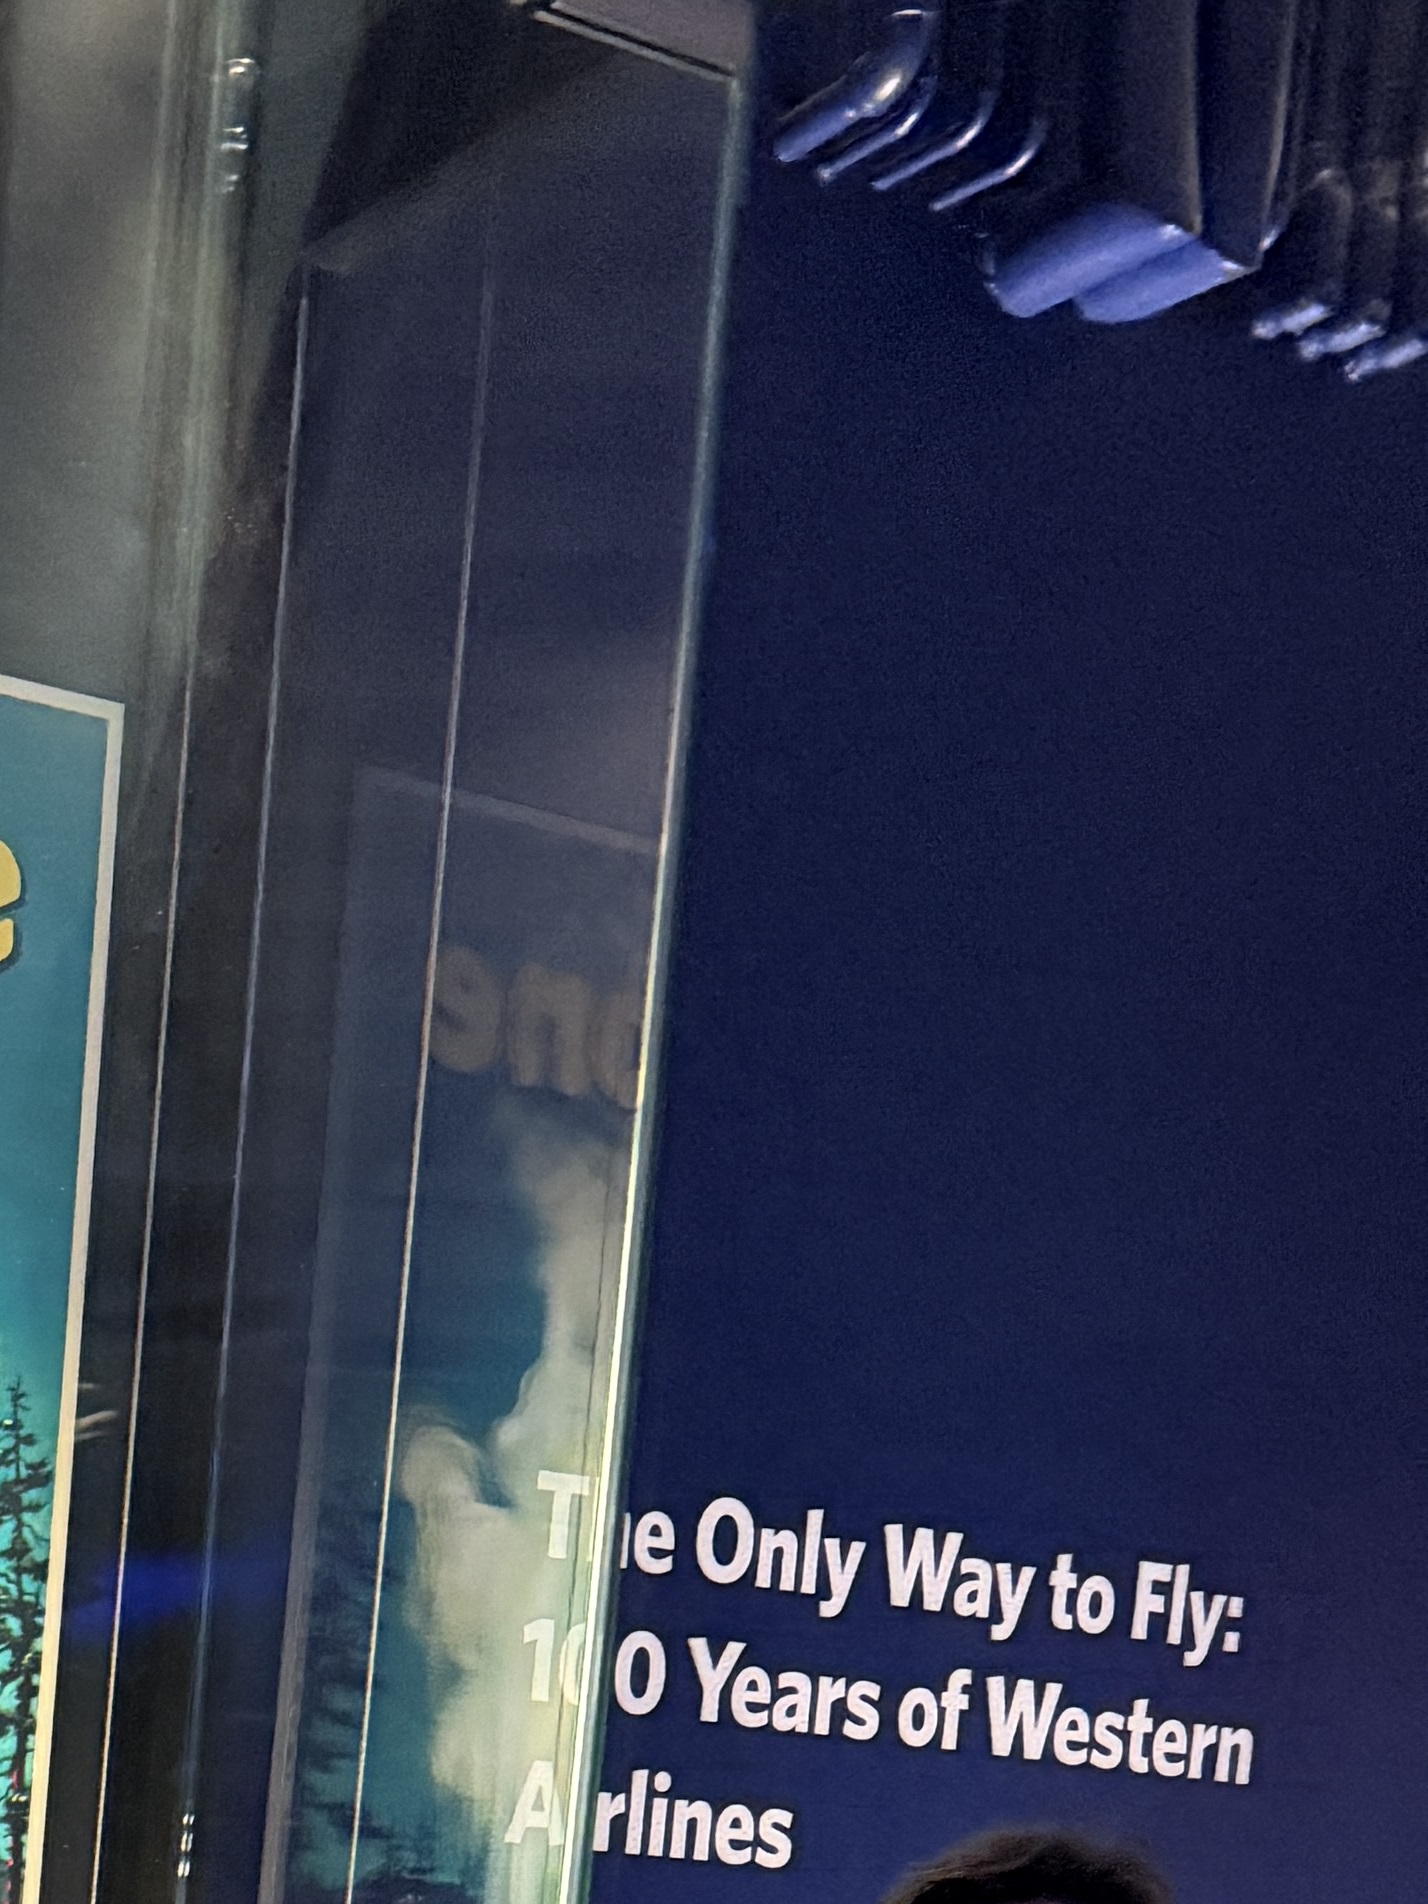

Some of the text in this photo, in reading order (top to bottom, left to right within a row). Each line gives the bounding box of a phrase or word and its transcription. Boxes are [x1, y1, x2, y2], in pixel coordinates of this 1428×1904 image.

[695, 1496, 867, 1618] Only
[883, 1523, 1037, 1641] Way
[1048, 1552, 1116, 1635] to
[1129, 1559, 1245, 1667] Fly:
[686, 1636, 882, 1741] Years
[897, 1668, 973, 1751] of
[985, 1674, 1255, 1786] Western
[503, 1759, 795, 1869] Arlines
